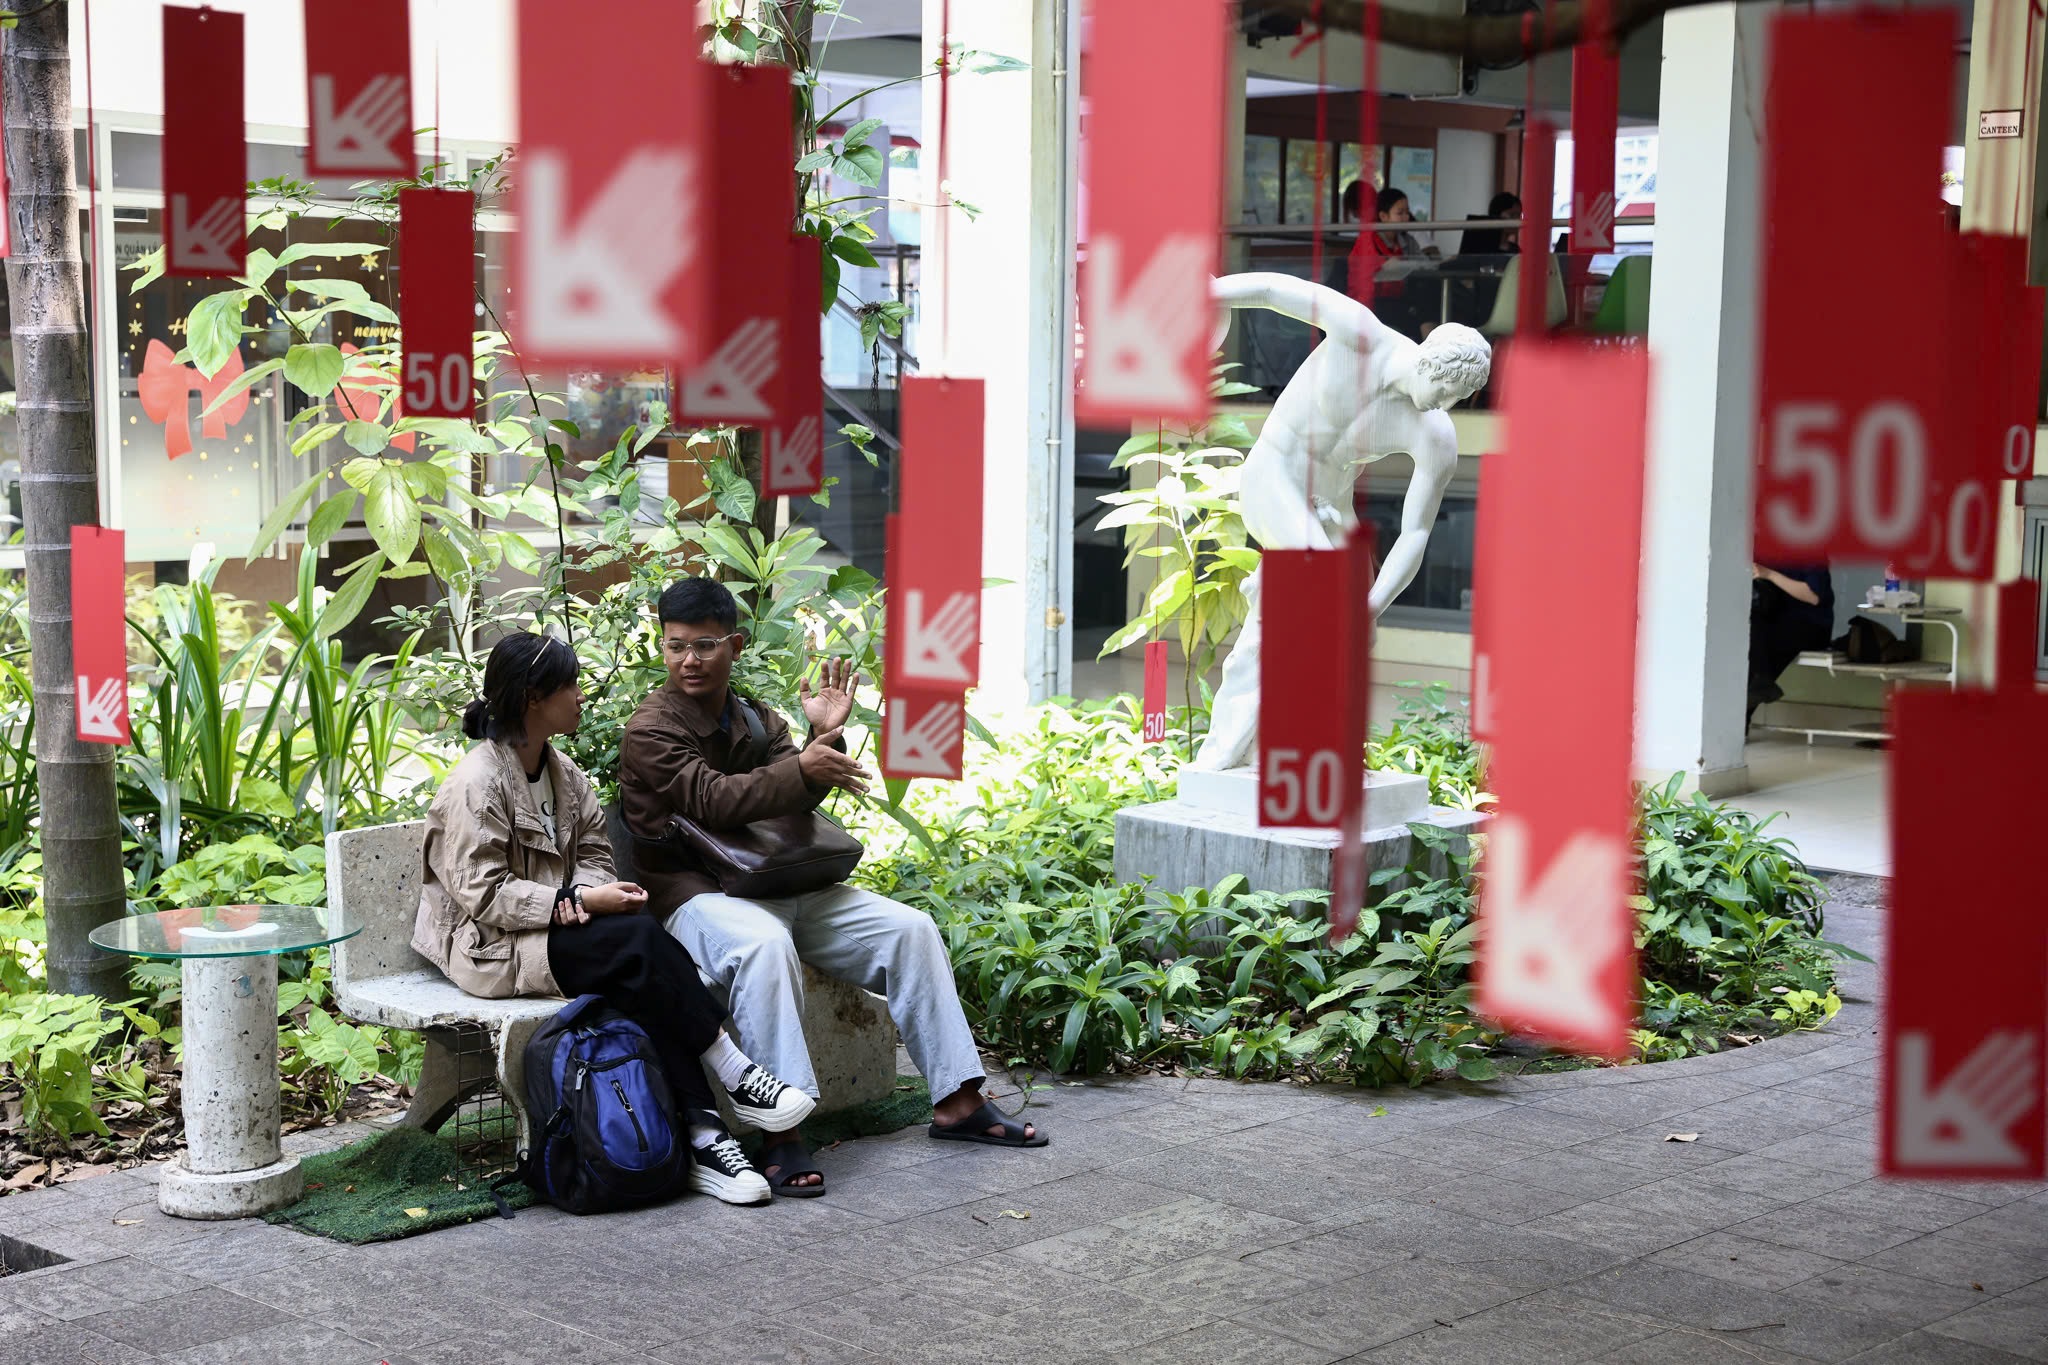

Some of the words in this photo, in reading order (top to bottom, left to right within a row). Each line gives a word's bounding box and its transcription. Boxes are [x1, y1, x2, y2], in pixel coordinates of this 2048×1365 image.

[1980, 126, 2018, 135] CANTEEN
[406, 352, 470, 412] 50
[1766, 401, 1926, 547] 50
[2003, 425, 2031, 475] 0
[1145, 711, 1164, 740] 50
[1263, 749, 1344, 824] 50
